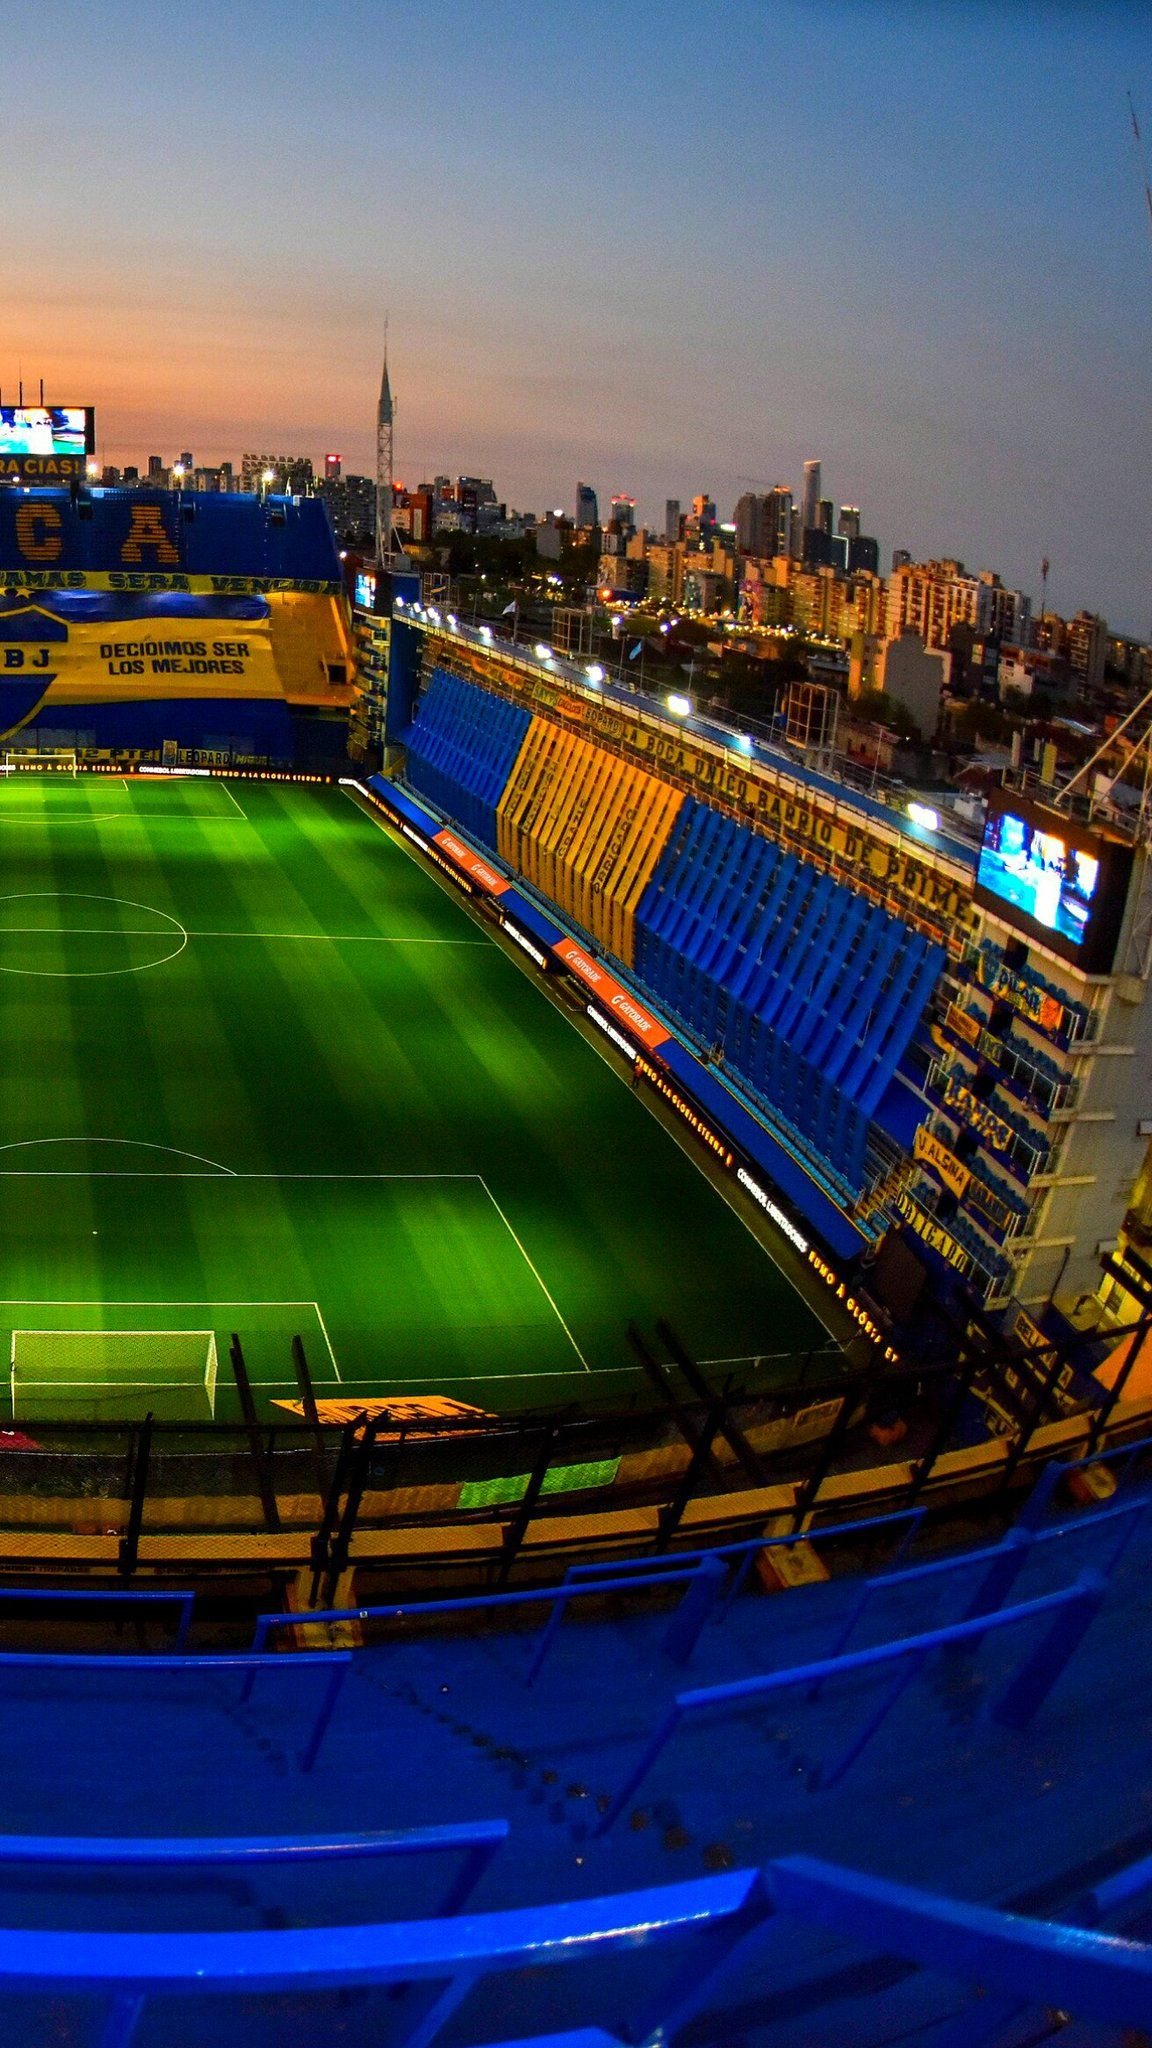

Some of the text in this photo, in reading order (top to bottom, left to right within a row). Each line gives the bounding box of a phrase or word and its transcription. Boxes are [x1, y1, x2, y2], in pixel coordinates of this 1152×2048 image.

[0, 571, 86, 588] AMAS
[109, 573, 189, 589] SERA
[100, 641, 250, 659] DECIDIMOS SER
[109, 659, 245, 676] LOS MEJORES
[646, 735, 684, 767] BOCA
[757, 787, 832, 846] BARRIO
[591, 807, 638, 894] OBRIGADO
[573, 956, 602, 982] GATORADE
[619, 1001, 653, 1031] GATORADE
[671, 1094, 699, 1127] GLORIA
[697, 1122, 726, 1157] ETERNA
[808, 1250, 836, 1285] RUMO
